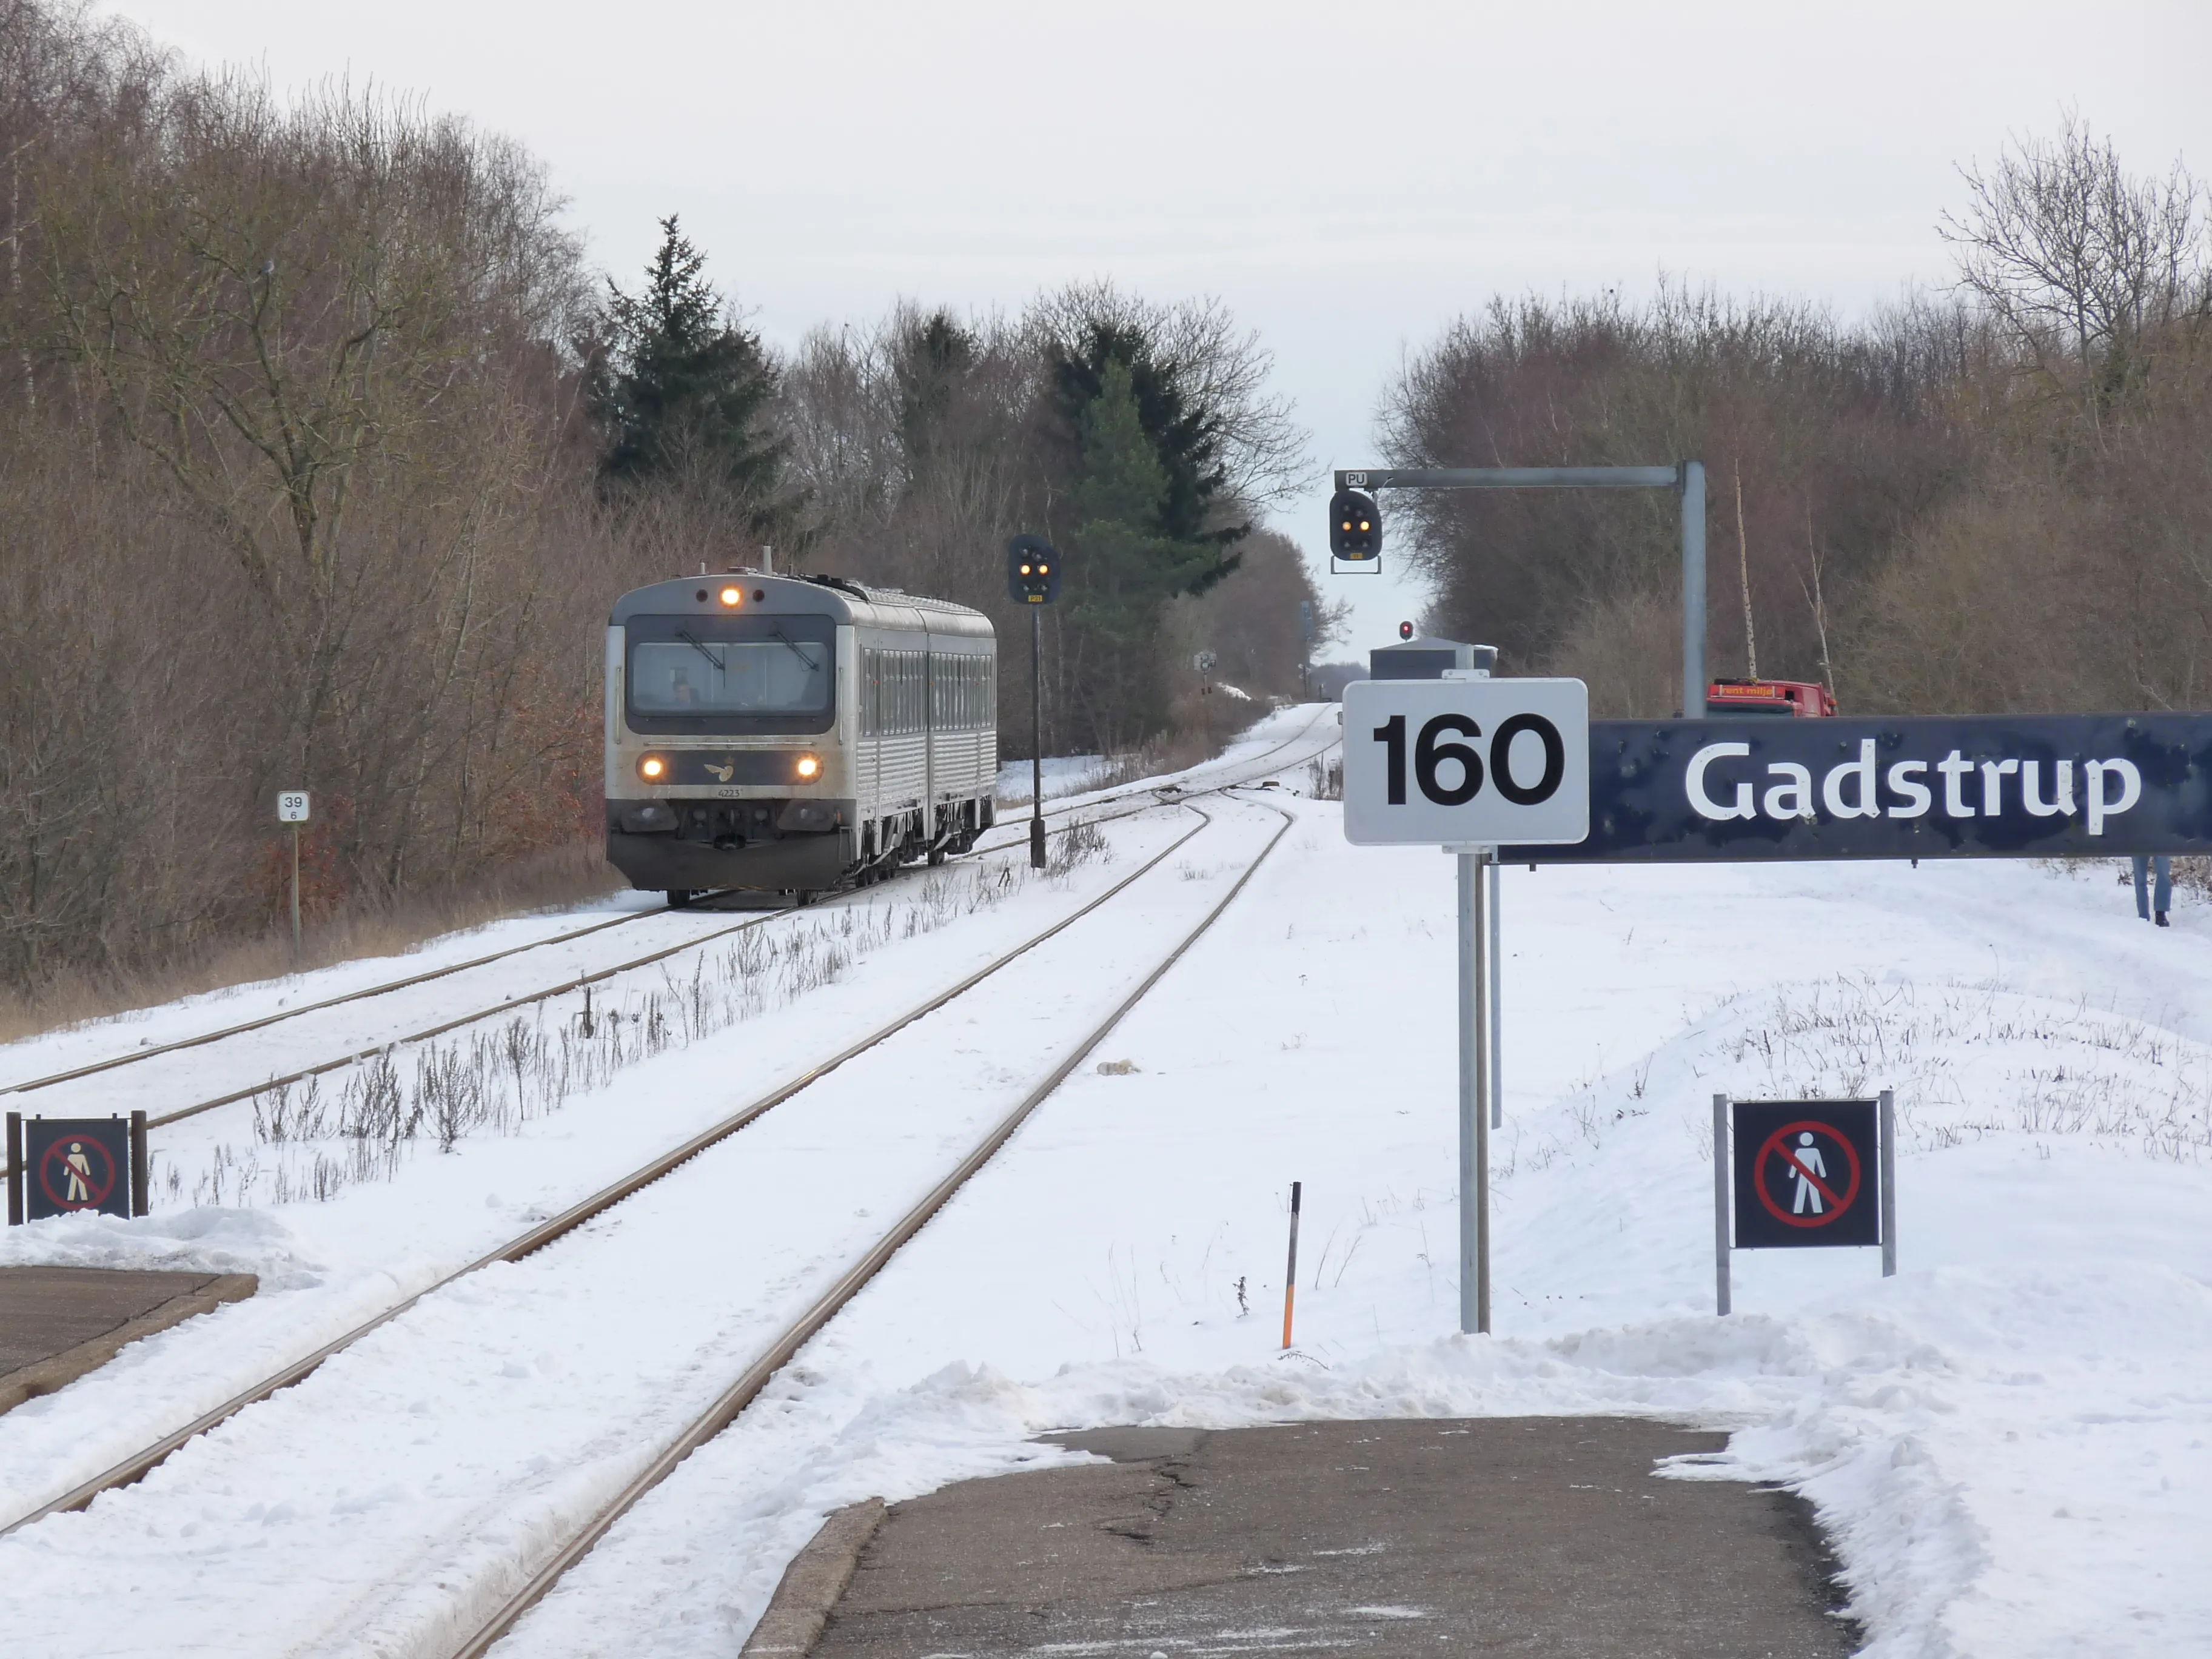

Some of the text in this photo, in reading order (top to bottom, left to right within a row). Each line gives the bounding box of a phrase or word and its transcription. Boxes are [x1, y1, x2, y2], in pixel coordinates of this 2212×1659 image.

[1349, 474, 1364, 484] PU
[1373, 712, 1565, 806] 160
[1684, 738, 2141, 836] Gadstrup
[285, 797, 302, 808] 39
[290, 811, 297, 820] 6
